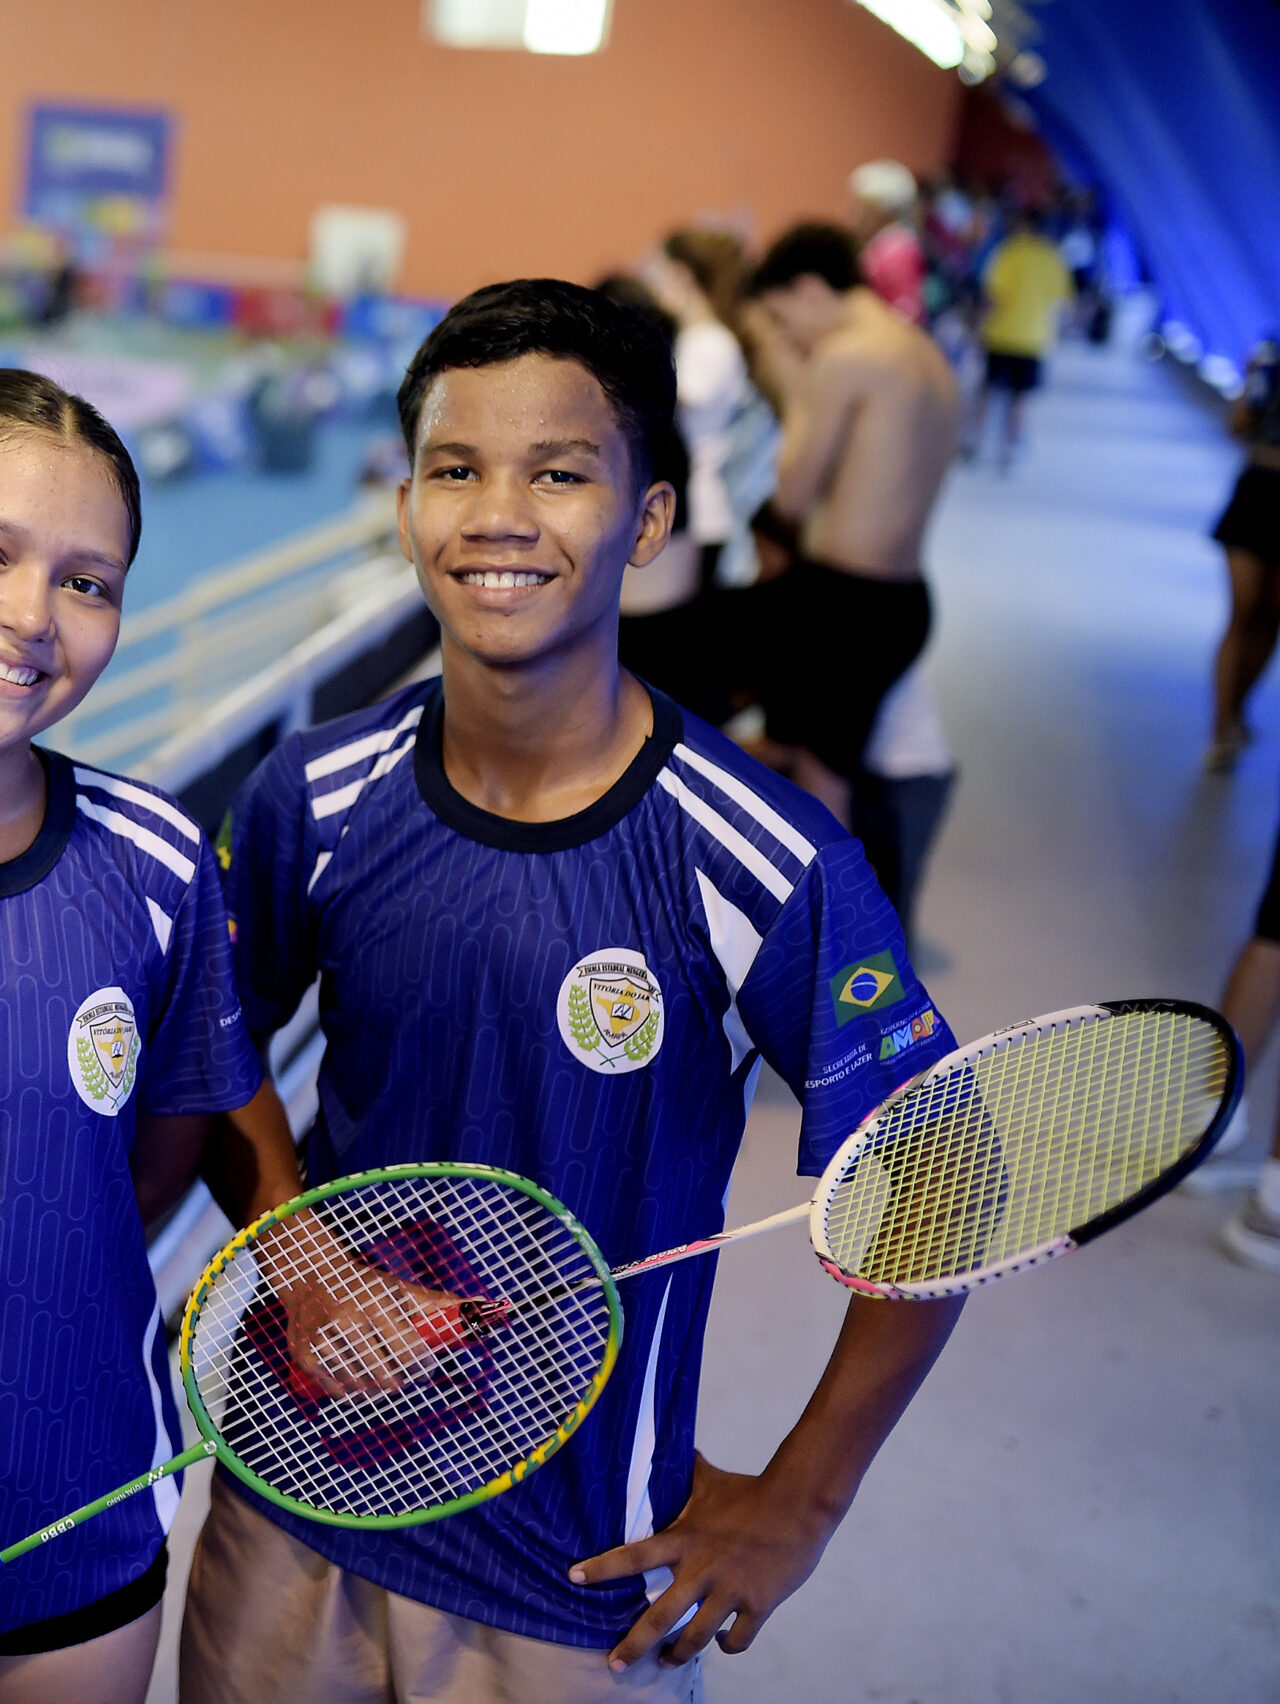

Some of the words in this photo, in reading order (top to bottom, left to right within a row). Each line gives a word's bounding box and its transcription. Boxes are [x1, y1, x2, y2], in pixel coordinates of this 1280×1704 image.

[593, 983, 624, 997] VITÓRIA
[845, 1066, 852, 1075] E
[851, 1053, 873, 1071] LAZER
[126, 1482, 145, 1497] TOTAL
